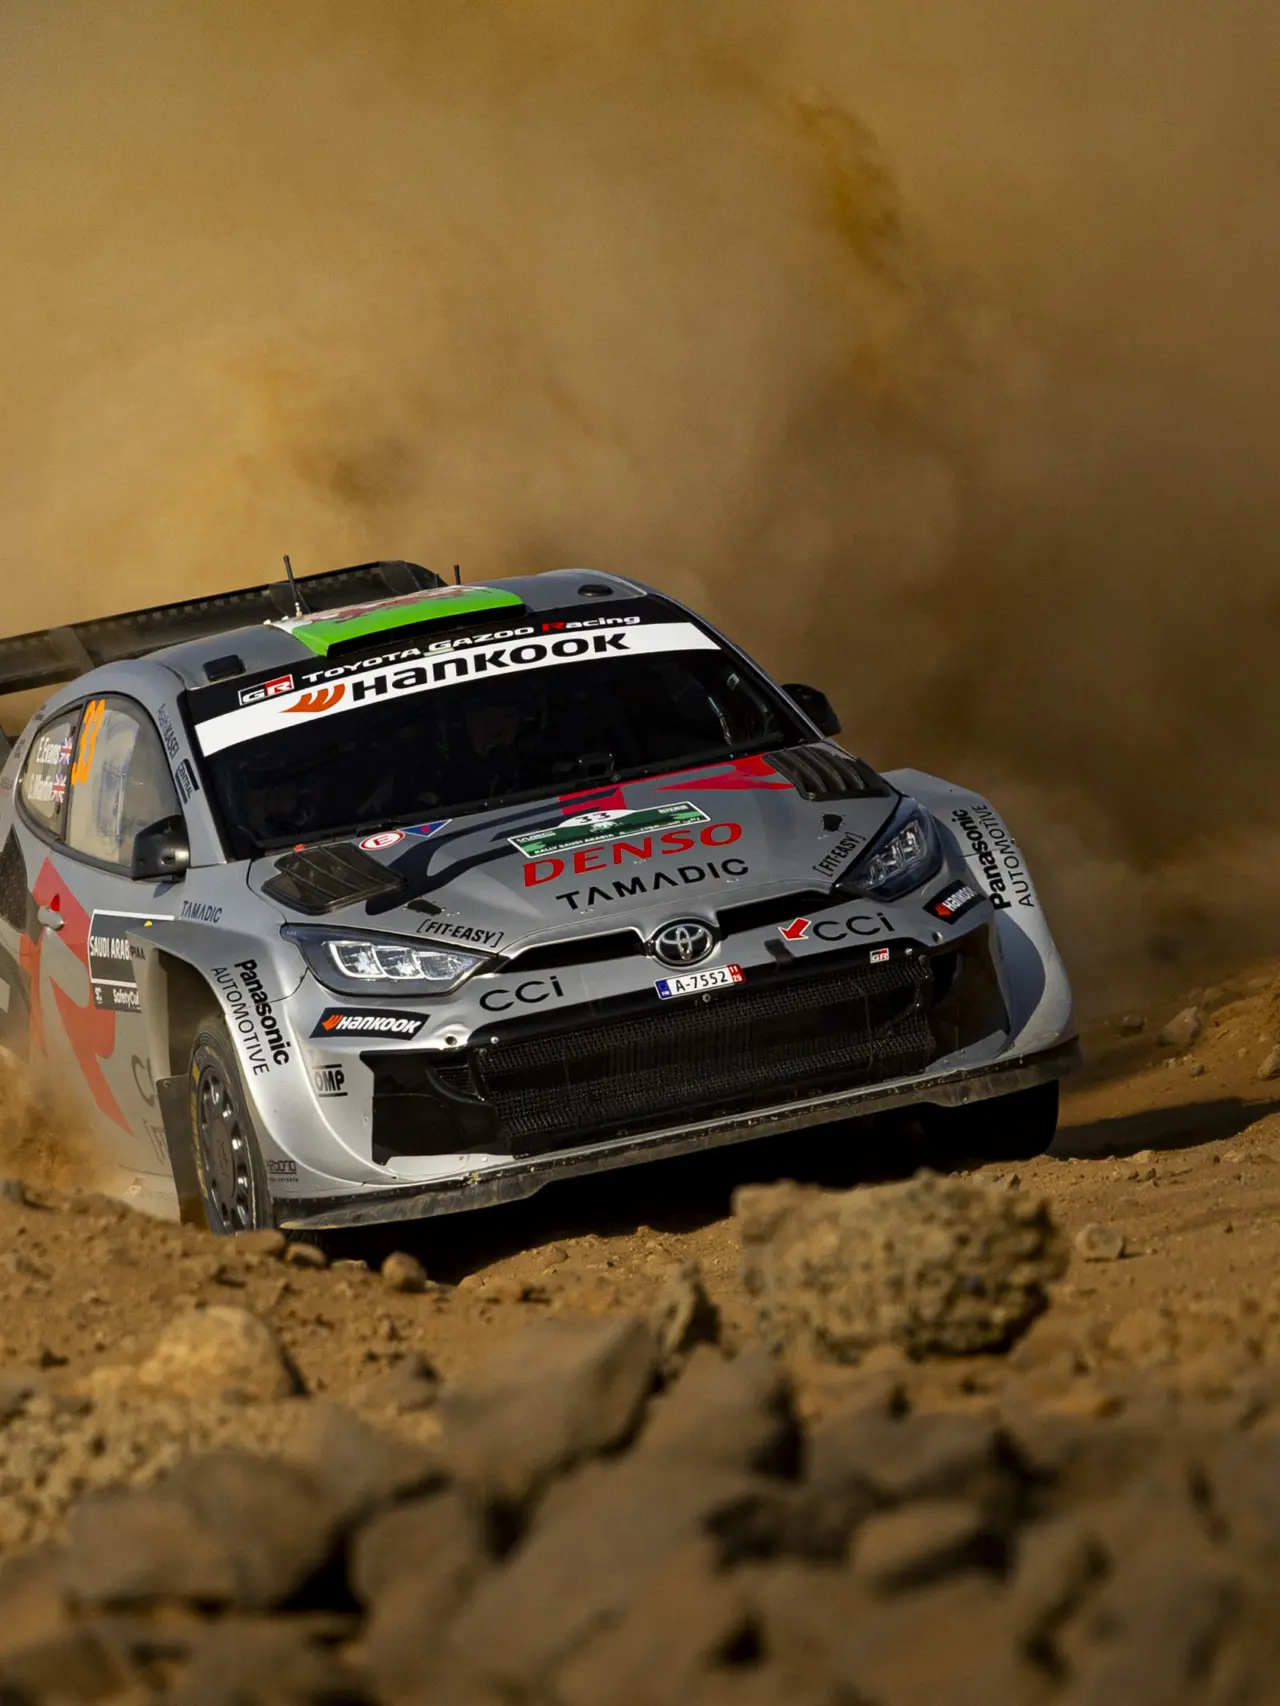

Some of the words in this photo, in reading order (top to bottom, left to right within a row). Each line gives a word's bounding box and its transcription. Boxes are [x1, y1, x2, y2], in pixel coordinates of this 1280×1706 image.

[302, 647, 421, 683] TOYOTA
[428, 626, 535, 652] GAZOO
[541, 616, 641, 632] Racing
[241, 679, 292, 704] GR
[71, 698, 106, 786] 33
[575, 811, 612, 824] 33
[522, 821, 743, 888] DENSO
[534, 845, 558, 855] RALLY
[558, 839, 584, 849] SAUDI
[584, 833, 614, 844] ARABIA
[951, 808, 1013, 911] Panasonic
[971, 803, 1035, 908] AUTOMOTIVE
[556, 858, 749, 910] TAMADIC
[181, 900, 223, 924] TAMADIC
[89, 935, 110, 958] SAUDI
[111, 938, 131, 961] ARAB
[674, 970, 729, 993] A-7552
[210, 966, 270, 1076] AUTOMOTIVE
[233, 958, 290, 1066] Panasonic
[314, 1069, 346, 1092] OMP
